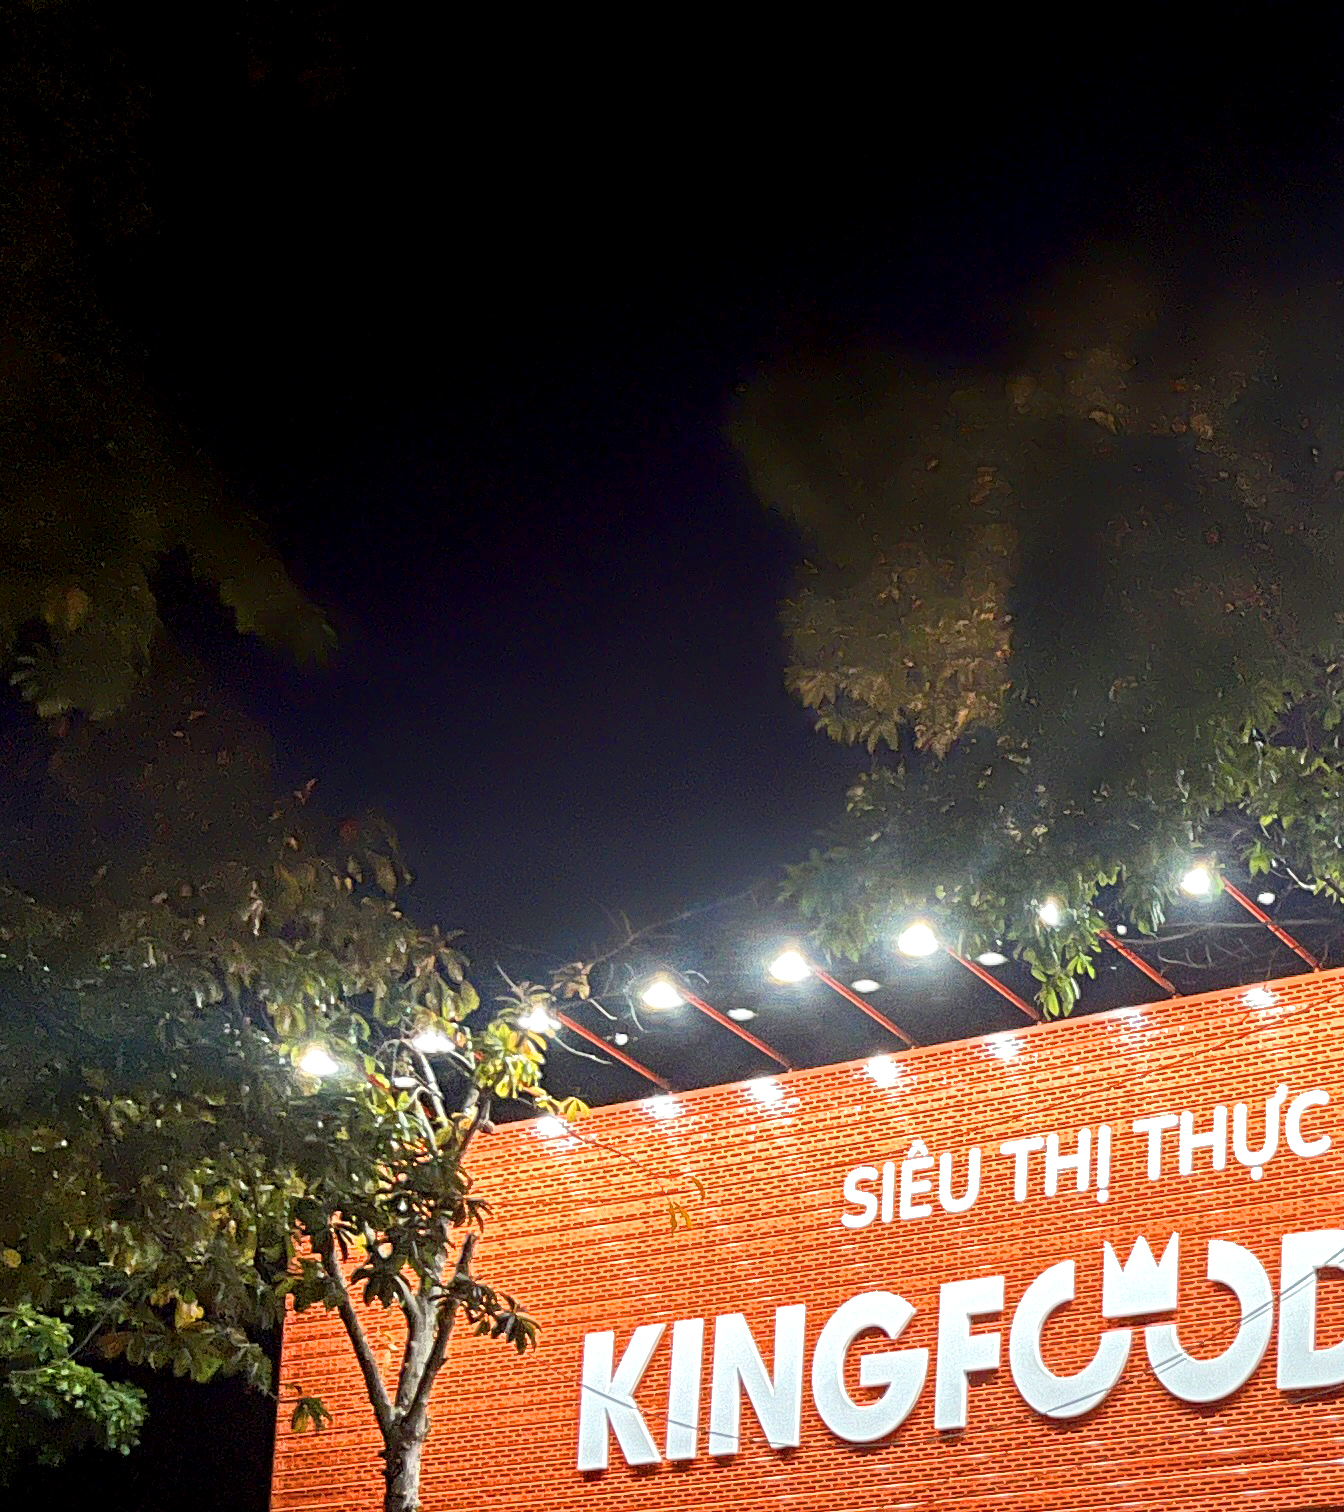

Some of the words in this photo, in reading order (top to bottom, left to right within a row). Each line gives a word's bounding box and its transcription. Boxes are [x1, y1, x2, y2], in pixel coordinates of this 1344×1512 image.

[841, 1139, 982, 1229] SIÊU
[1000, 1124, 1112, 1204] THỊ
[1132, 1083, 1331, 1182] THỰC
